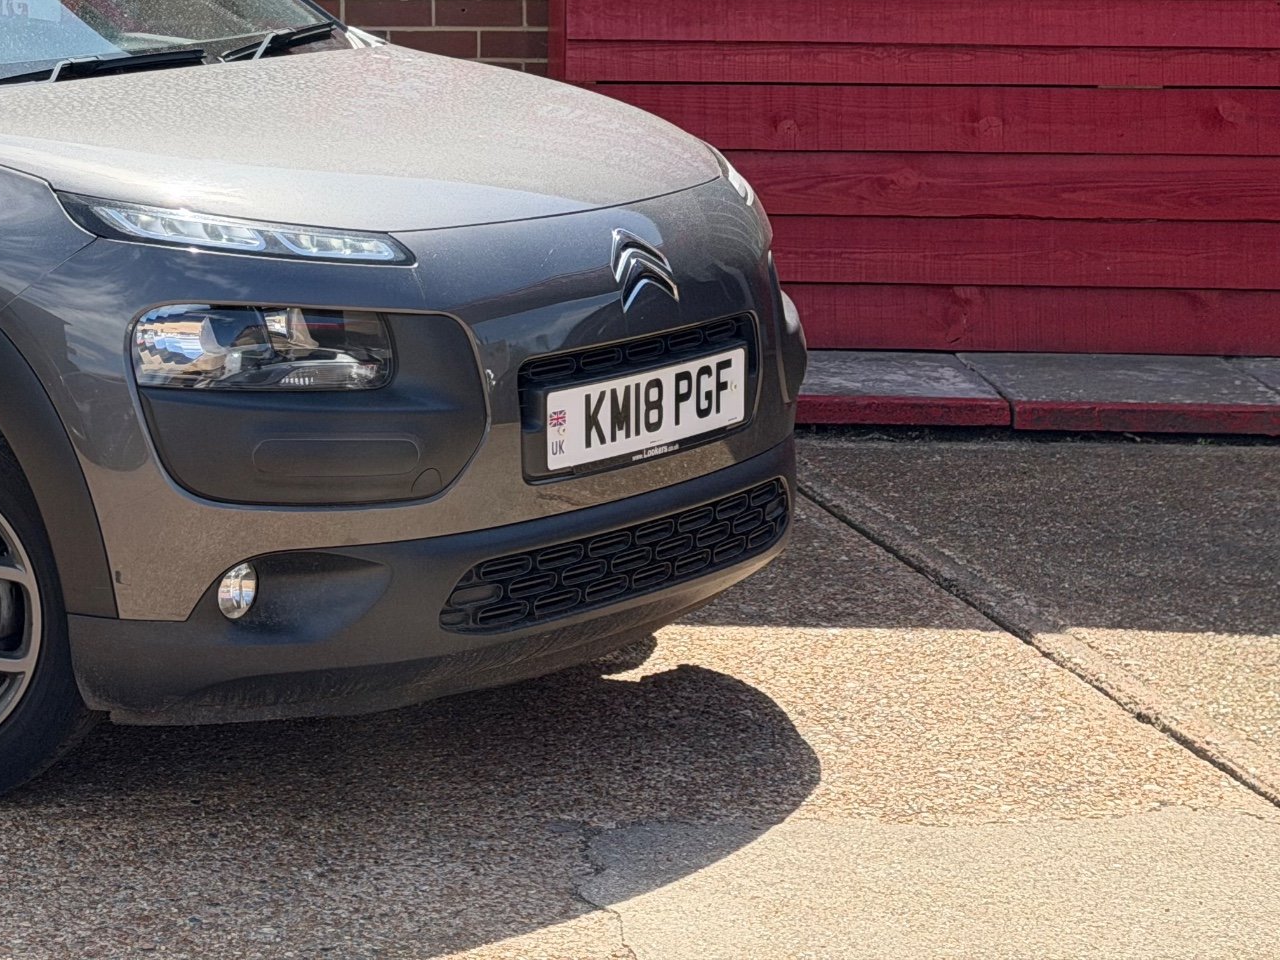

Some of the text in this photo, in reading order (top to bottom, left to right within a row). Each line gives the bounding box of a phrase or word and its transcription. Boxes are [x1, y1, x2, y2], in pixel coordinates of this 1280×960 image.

[585, 358, 733, 449] KM18 PGF
[551, 439, 565, 456] UK
